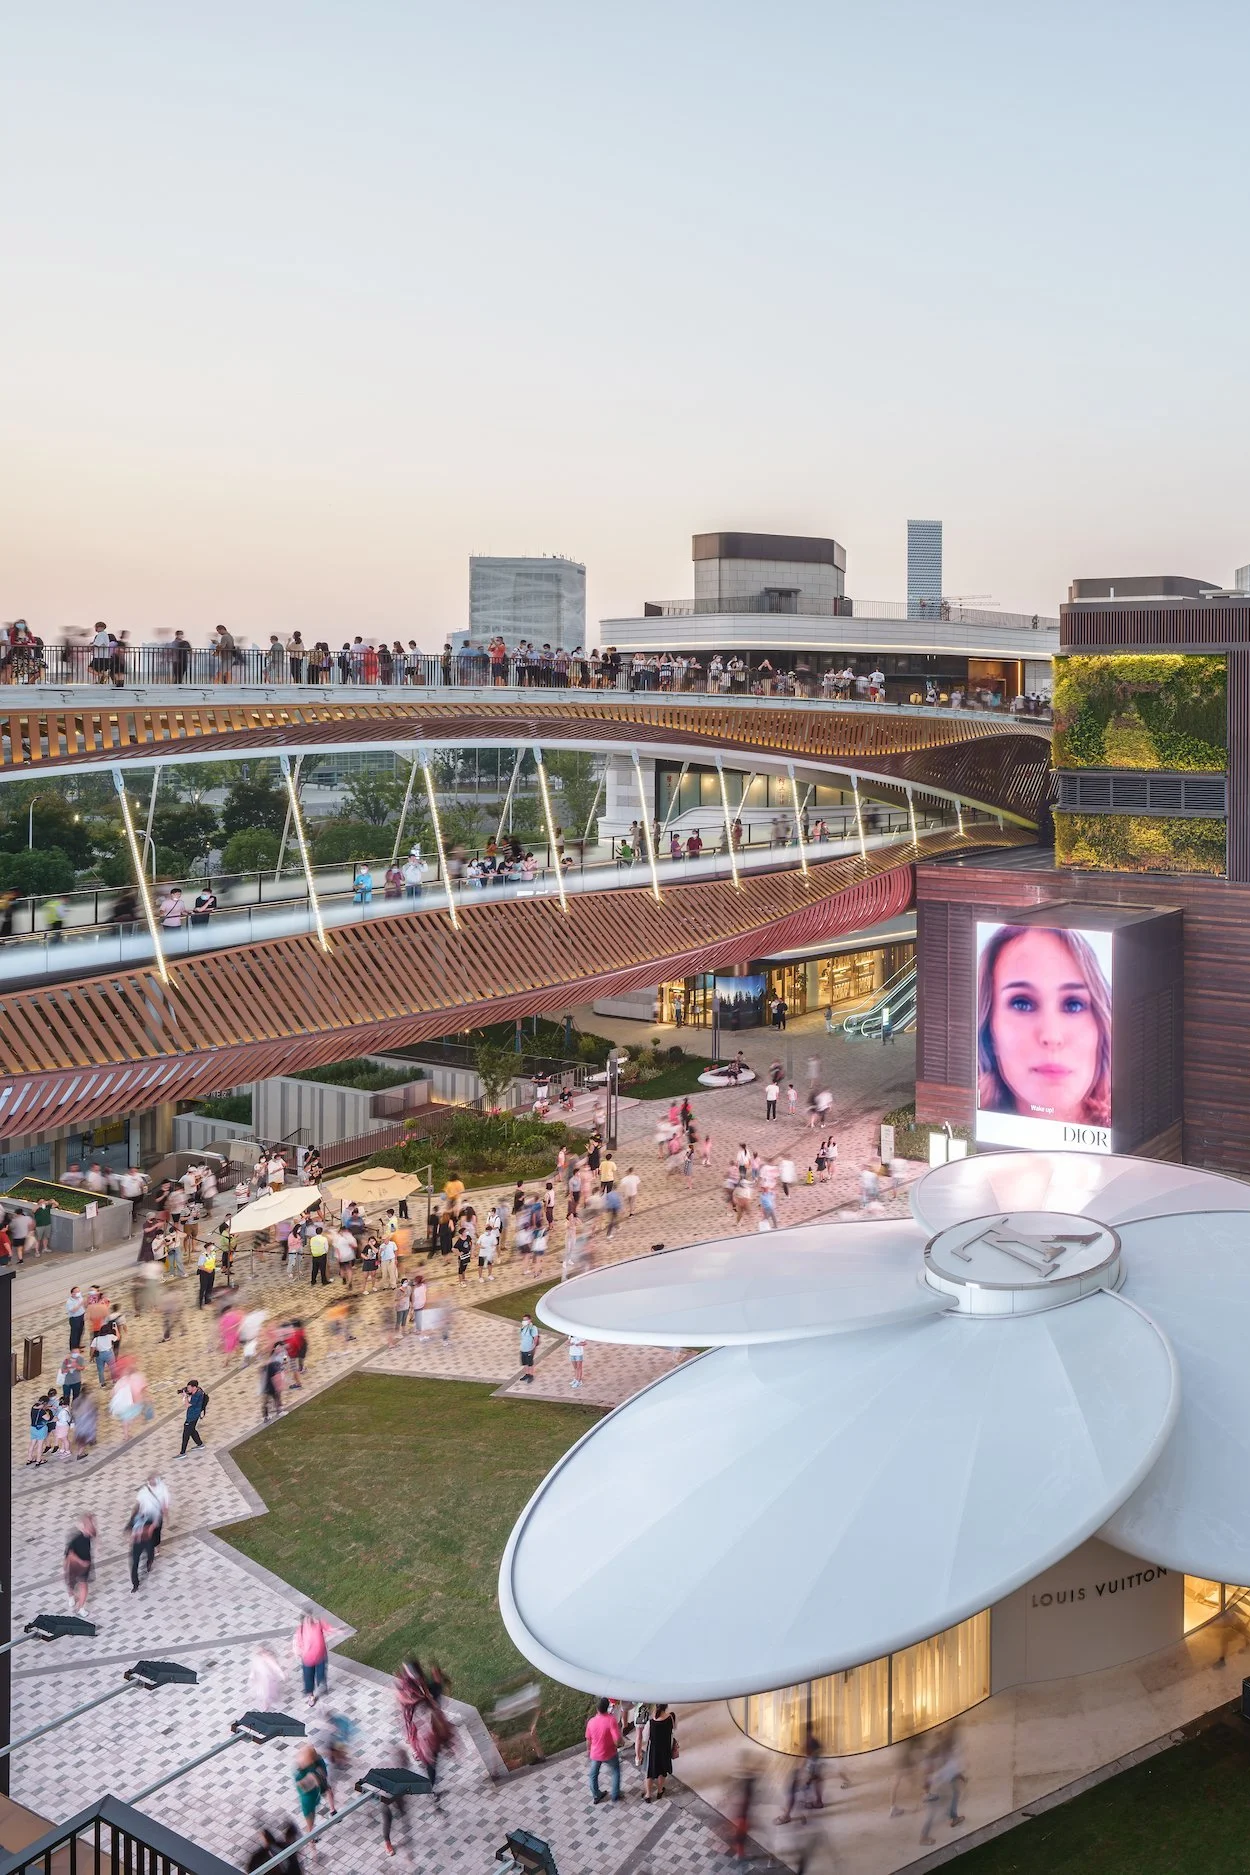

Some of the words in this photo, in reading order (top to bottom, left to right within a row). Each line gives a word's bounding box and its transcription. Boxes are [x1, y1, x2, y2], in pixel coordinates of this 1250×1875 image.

[1063, 1126, 1108, 1147] DIOR
[1031, 1588, 1086, 1608] LOUIS
[1095, 1565, 1168, 1597] VUITTON
